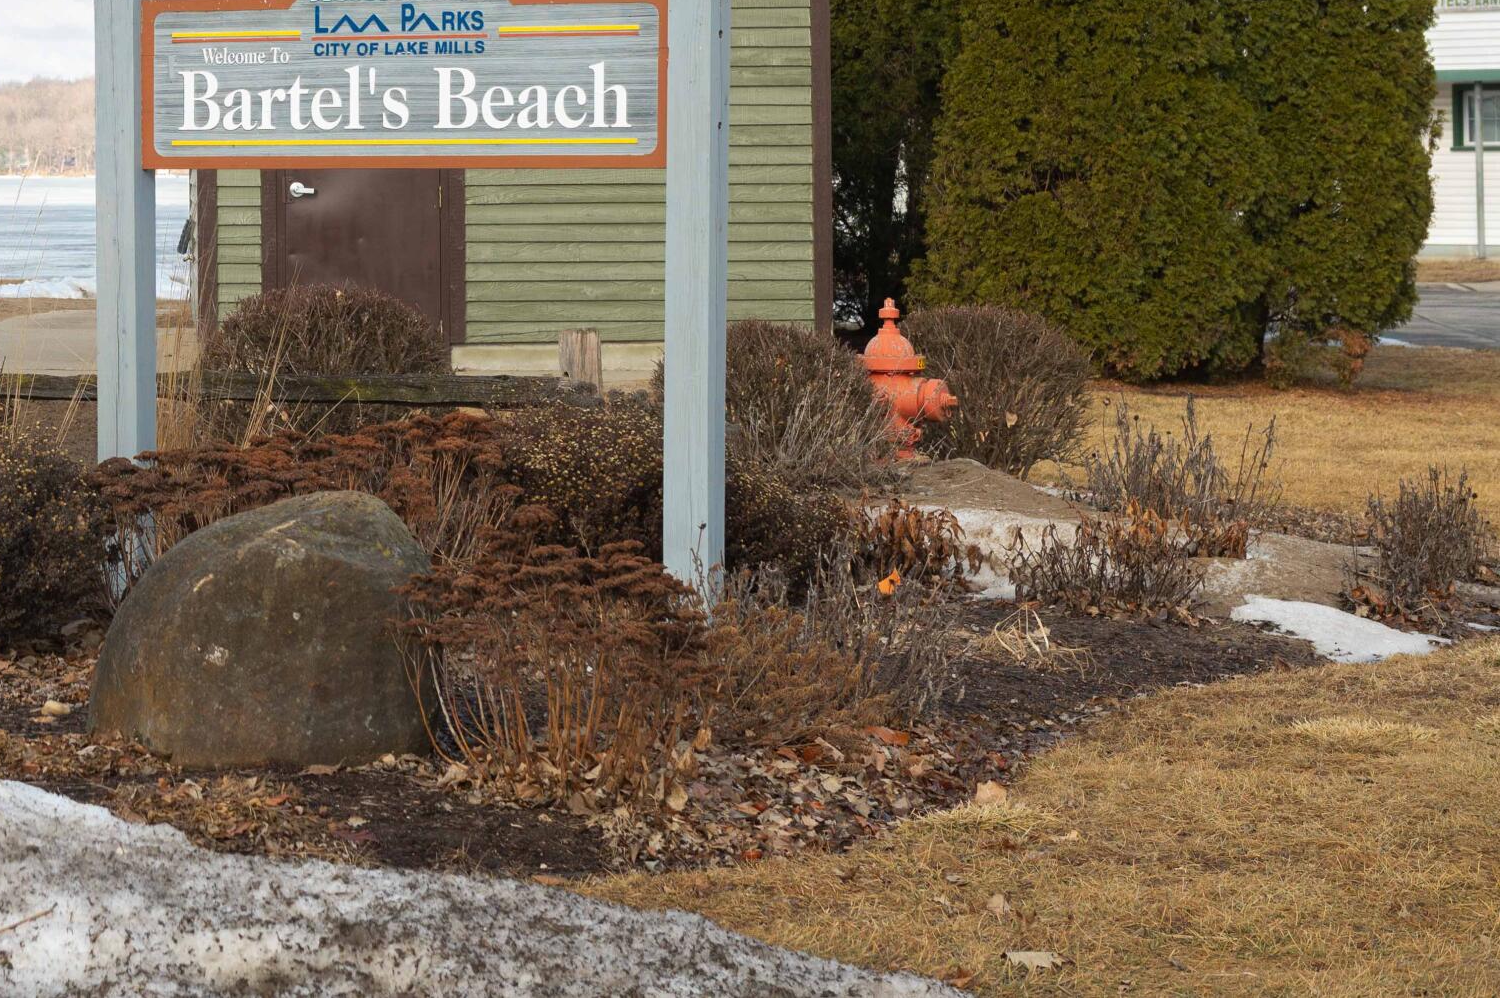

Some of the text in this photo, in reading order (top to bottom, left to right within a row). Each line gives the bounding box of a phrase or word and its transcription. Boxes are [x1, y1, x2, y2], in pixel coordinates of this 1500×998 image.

[202, 47, 290, 65] Welcome To
[314, 40, 485, 56] CITY OF LAKE MILLS
[178, 61, 632, 131] Bartel's Beach
